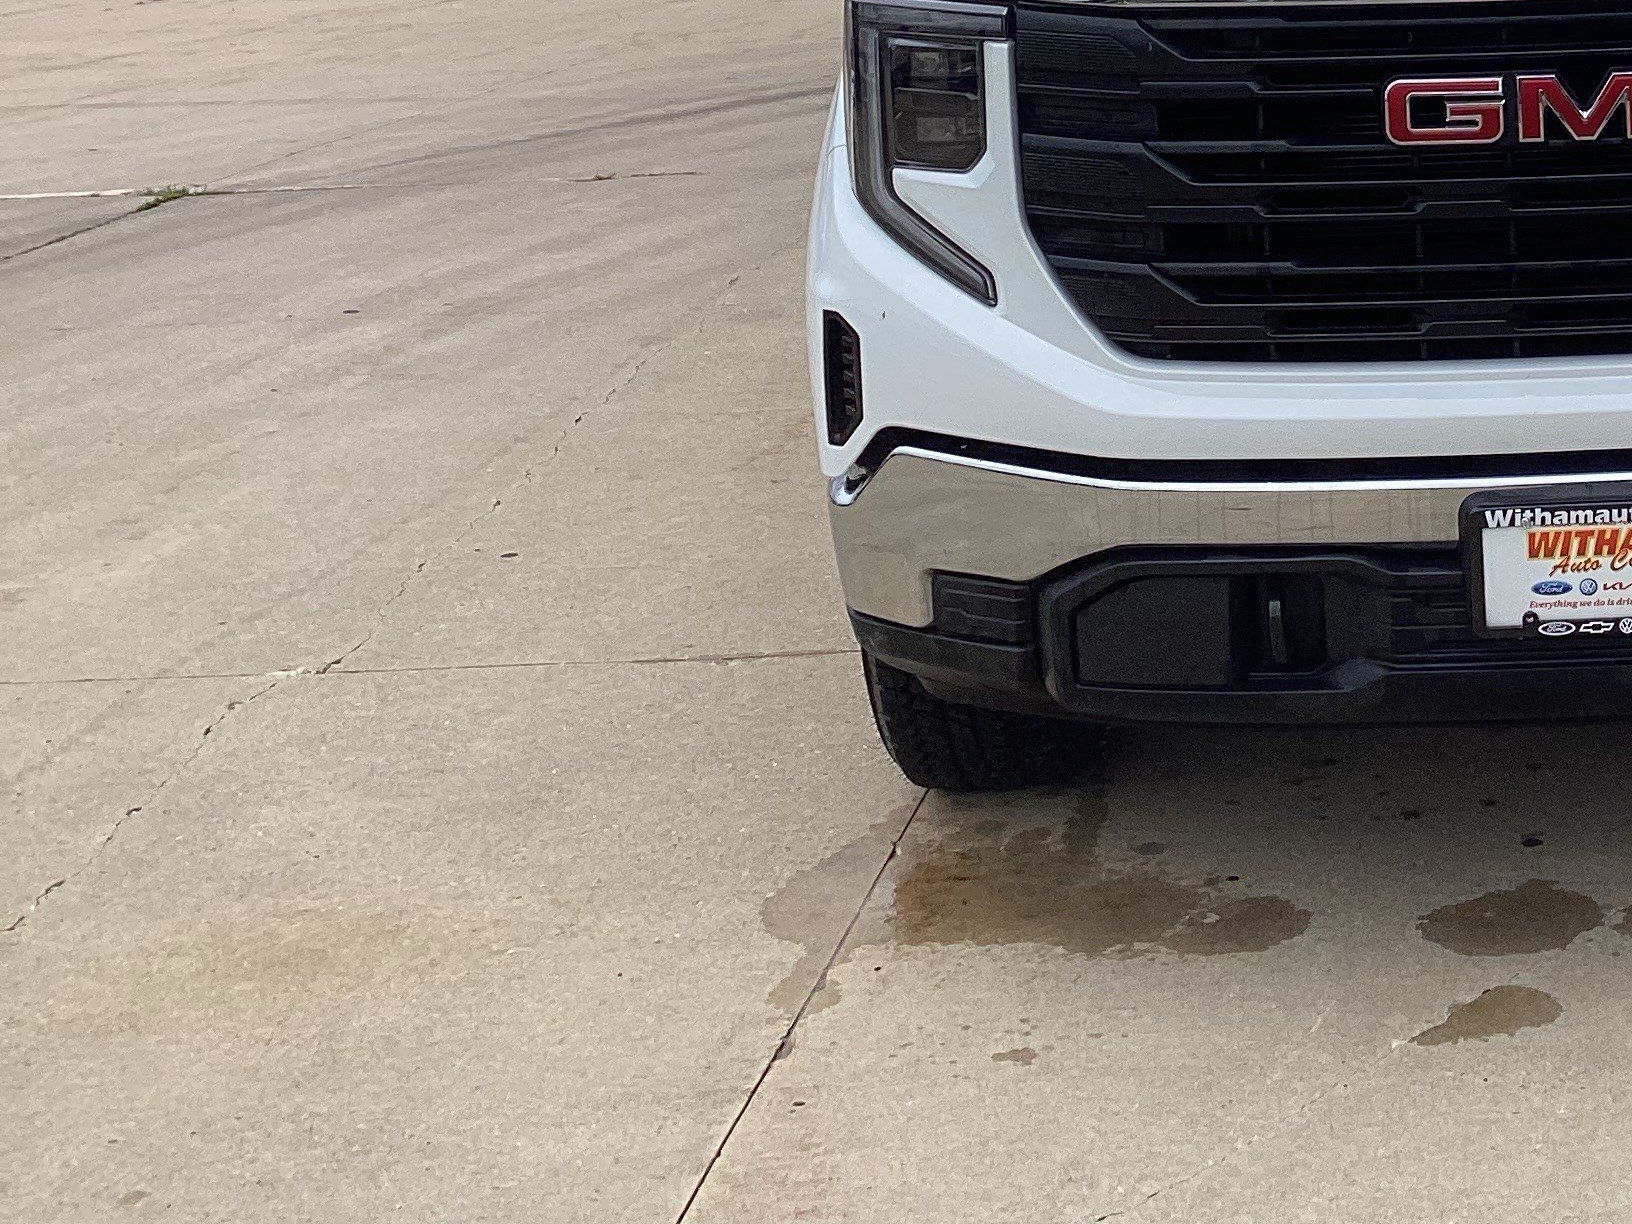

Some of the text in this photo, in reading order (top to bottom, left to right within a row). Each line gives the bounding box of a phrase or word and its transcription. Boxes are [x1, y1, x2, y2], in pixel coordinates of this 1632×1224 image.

[1549, 556, 1602, 577] Auto
[1529, 598, 1579, 610] Everything
[1594, 598, 1606, 607] do
[1607, 597, 1614, 606] is
